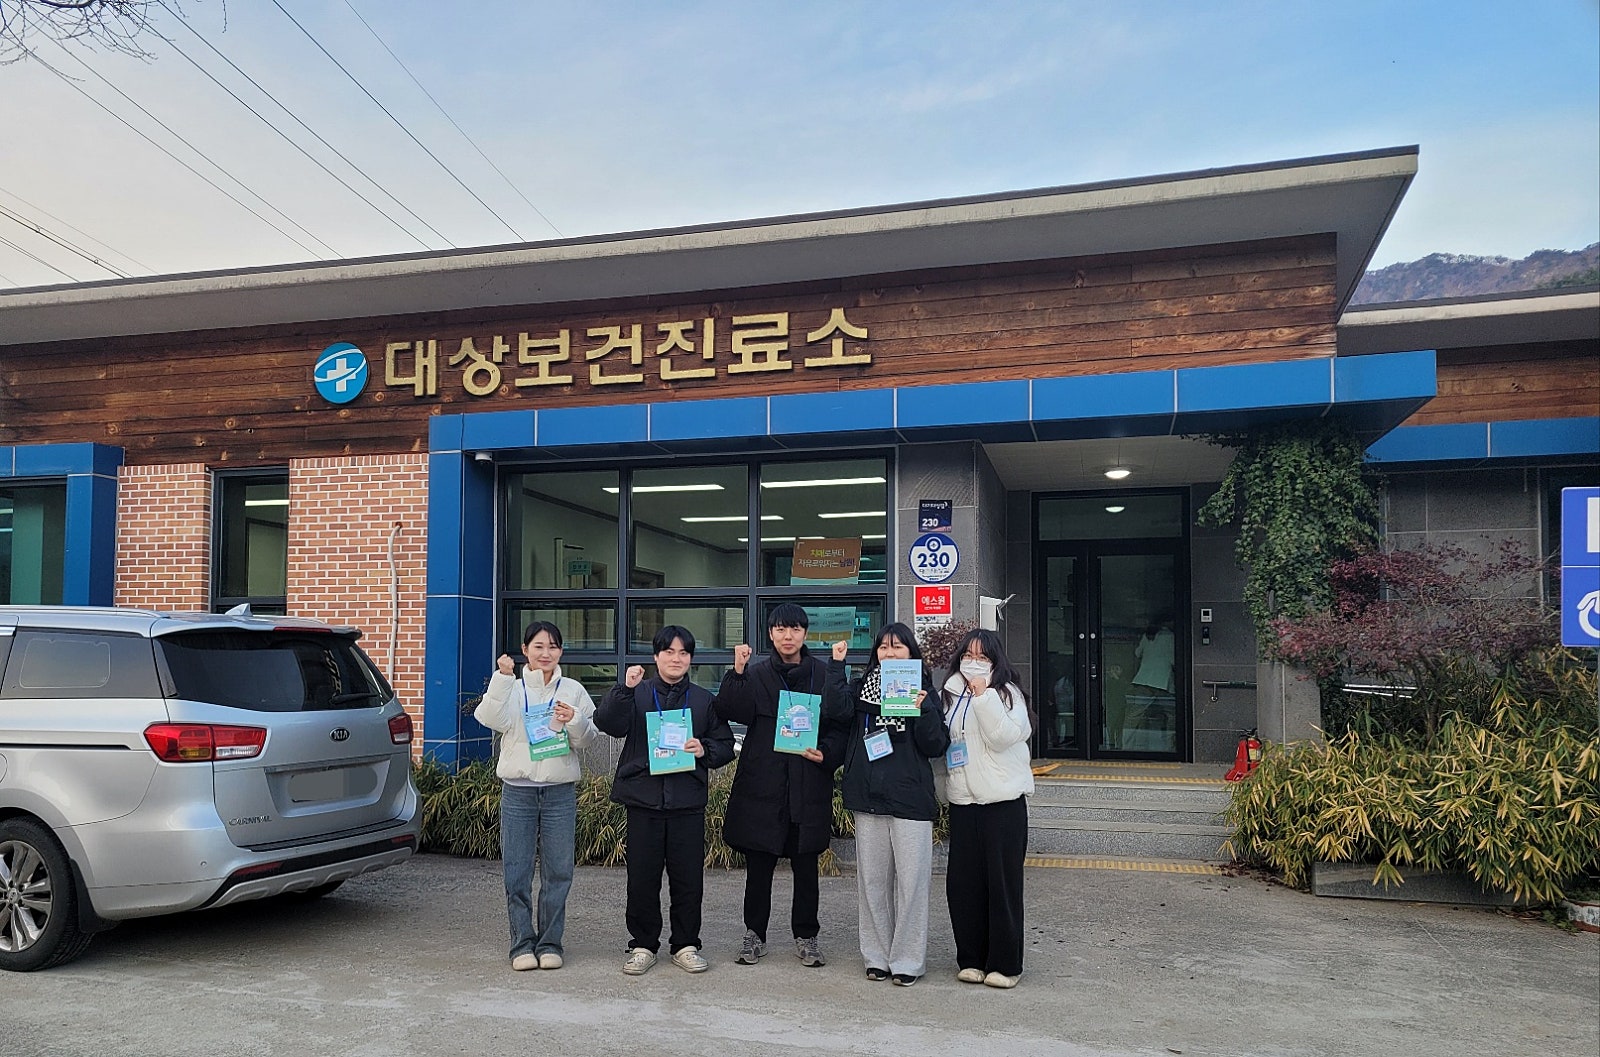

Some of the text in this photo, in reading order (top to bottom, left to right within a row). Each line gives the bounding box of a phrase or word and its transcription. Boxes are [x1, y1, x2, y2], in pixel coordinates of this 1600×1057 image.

[383, 307, 873, 397] 대상보건진료소
[922, 518, 939, 527] 230
[918, 552, 950, 568] 230
[333, 730, 349, 740] KIA
